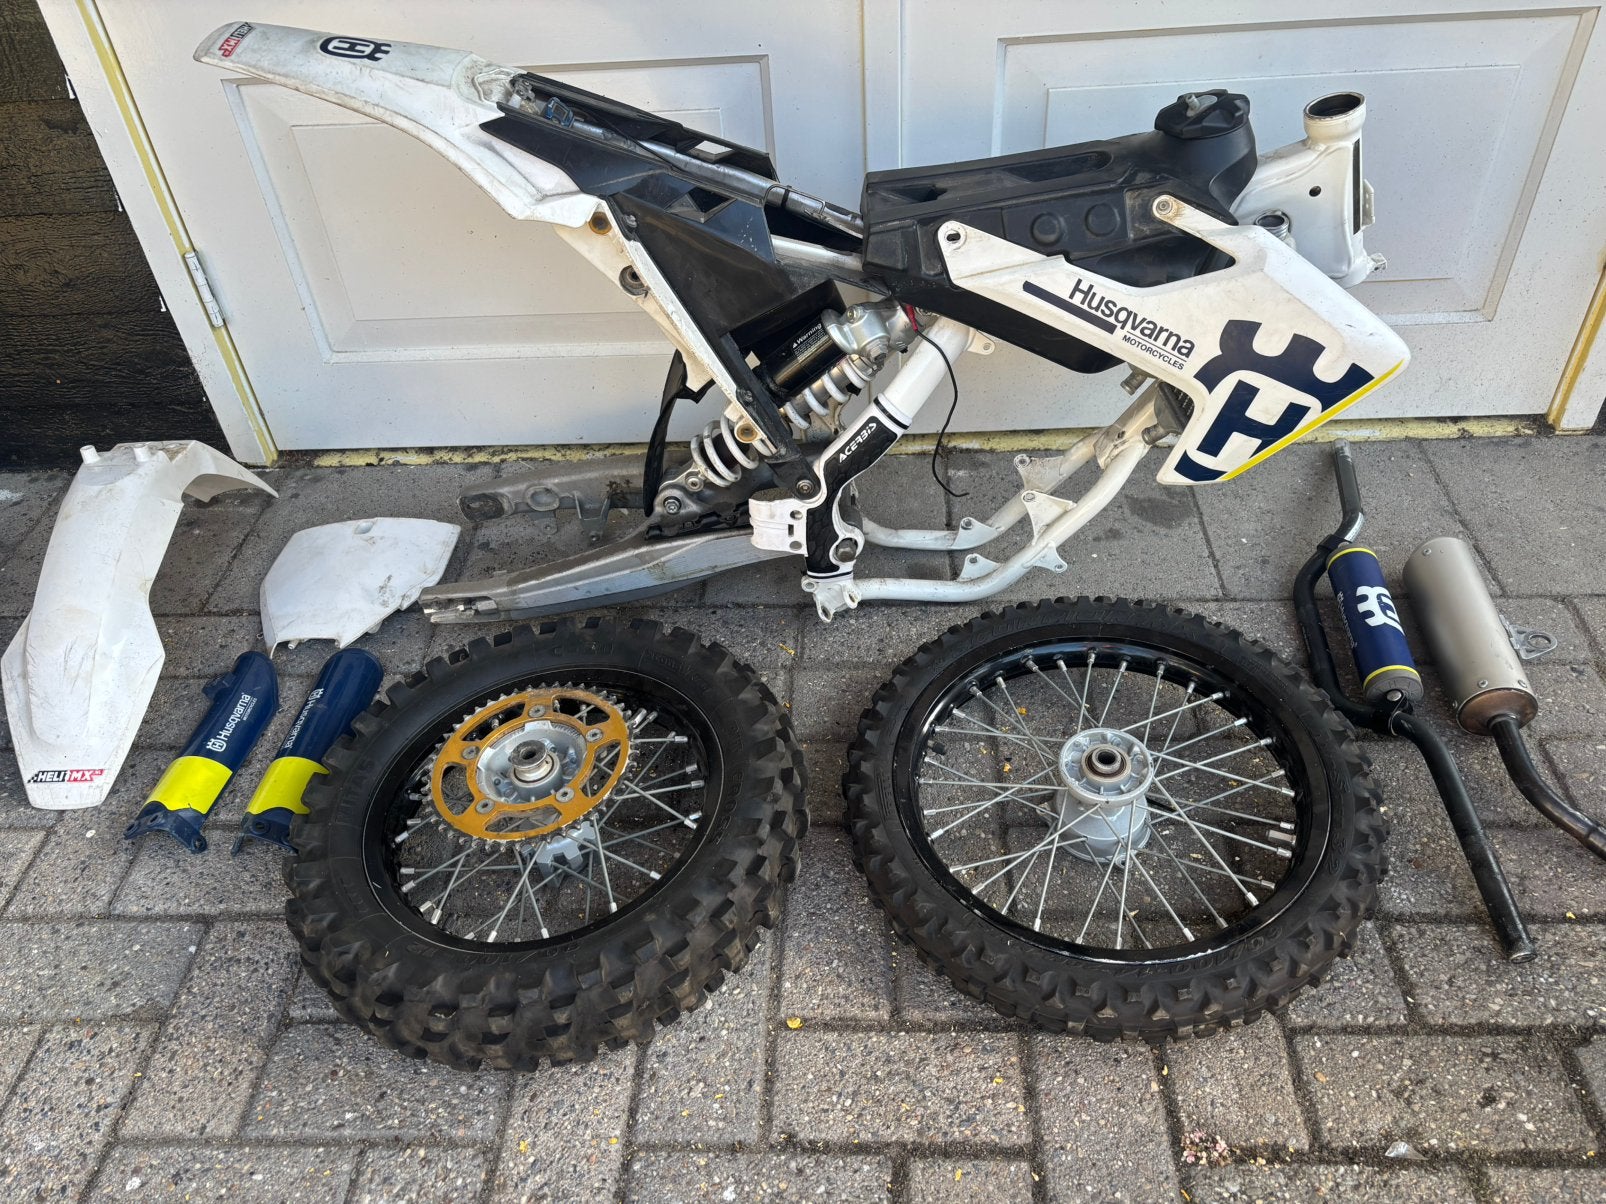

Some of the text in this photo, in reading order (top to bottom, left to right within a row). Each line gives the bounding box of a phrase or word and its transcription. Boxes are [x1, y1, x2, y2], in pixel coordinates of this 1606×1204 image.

[796, 323, 822, 344] Warning
[1069, 278, 1196, 359] Husqvarna
[1122, 334, 1185, 371] MOTORCYCLES
[217, 693, 251, 741] Husqvarna
[284, 698, 317, 749] Husqvarna
[37, 771, 64, 782] HELI
[70, 770, 94, 781] MX
